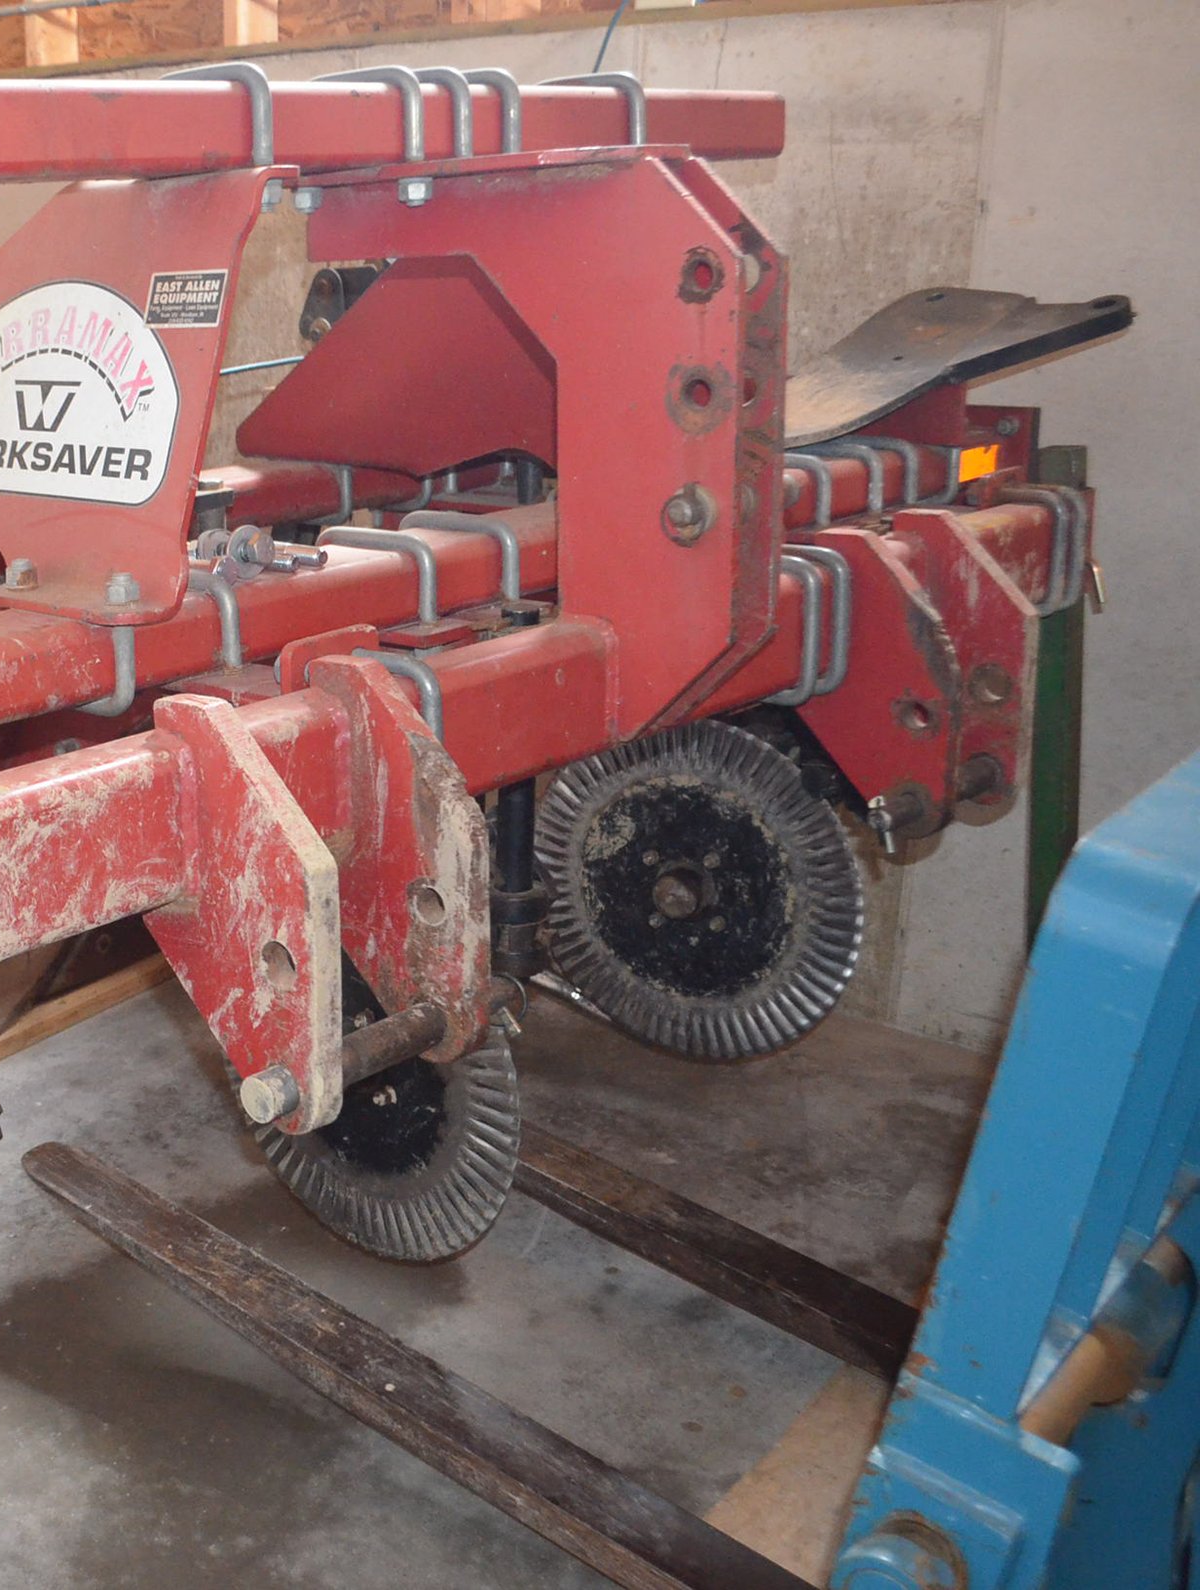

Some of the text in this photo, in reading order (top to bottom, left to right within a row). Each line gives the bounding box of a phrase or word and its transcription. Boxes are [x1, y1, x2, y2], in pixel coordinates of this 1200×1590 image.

[155, 279, 220, 293] EAST ALLEN
[153, 292, 218, 304] EQUIPMENT
